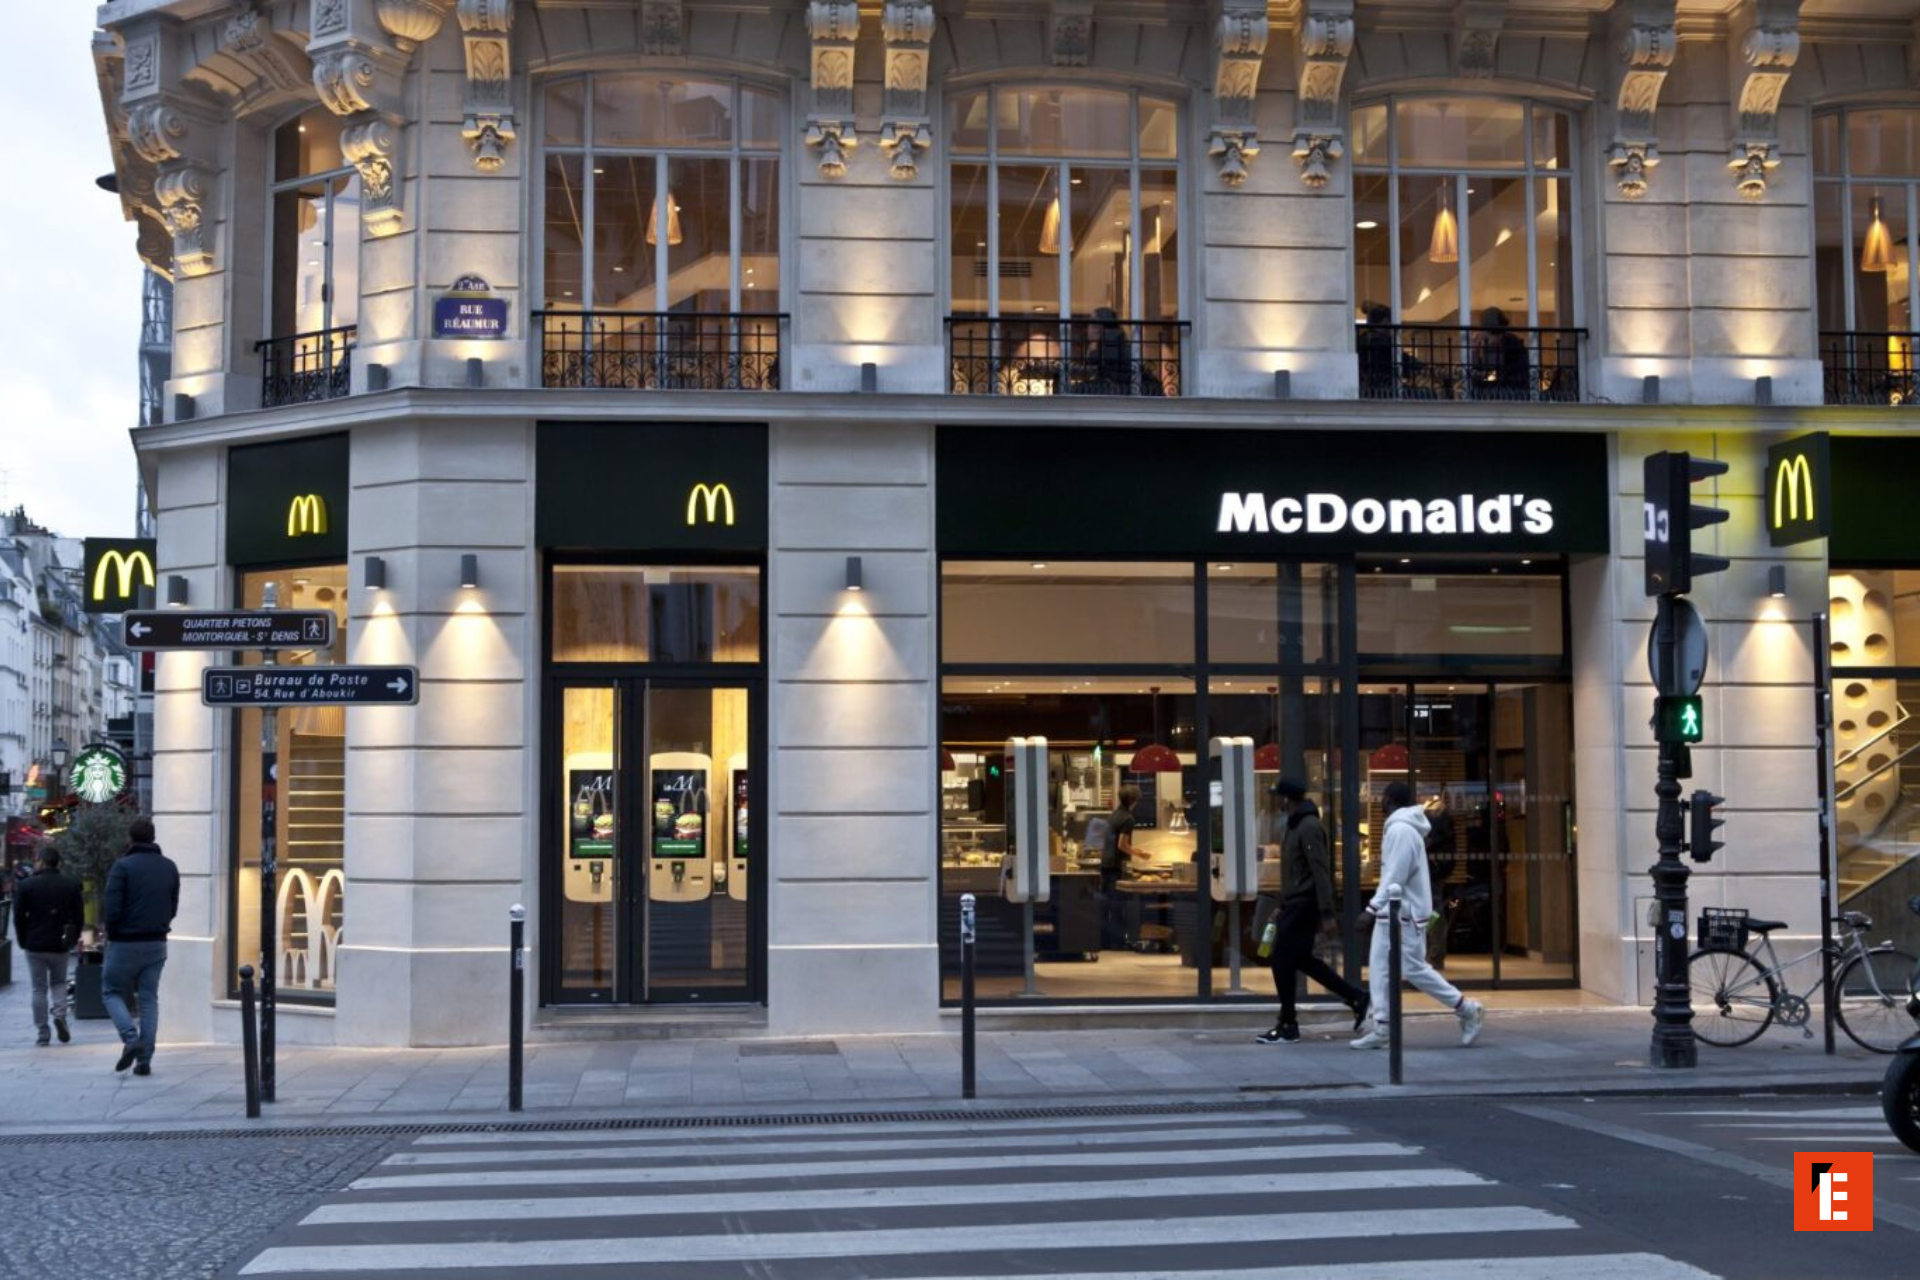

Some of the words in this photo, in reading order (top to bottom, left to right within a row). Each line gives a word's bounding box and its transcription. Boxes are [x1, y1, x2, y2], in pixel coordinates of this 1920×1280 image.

[460, 304, 483, 315] RUE
[444, 316, 499, 329] RÉAUMUR
[1216, 492, 1554, 534] McDonald's
[182, 618, 230, 629] QUARTIER
[182, 631, 250, 642] MONTORGUEIL
[271, 631, 300, 641] DENIS
[254, 674, 303, 686] Bureau
[308, 674, 324, 686] de
[330, 673, 369, 686] Poste
[274, 688, 295, 699] Rue
